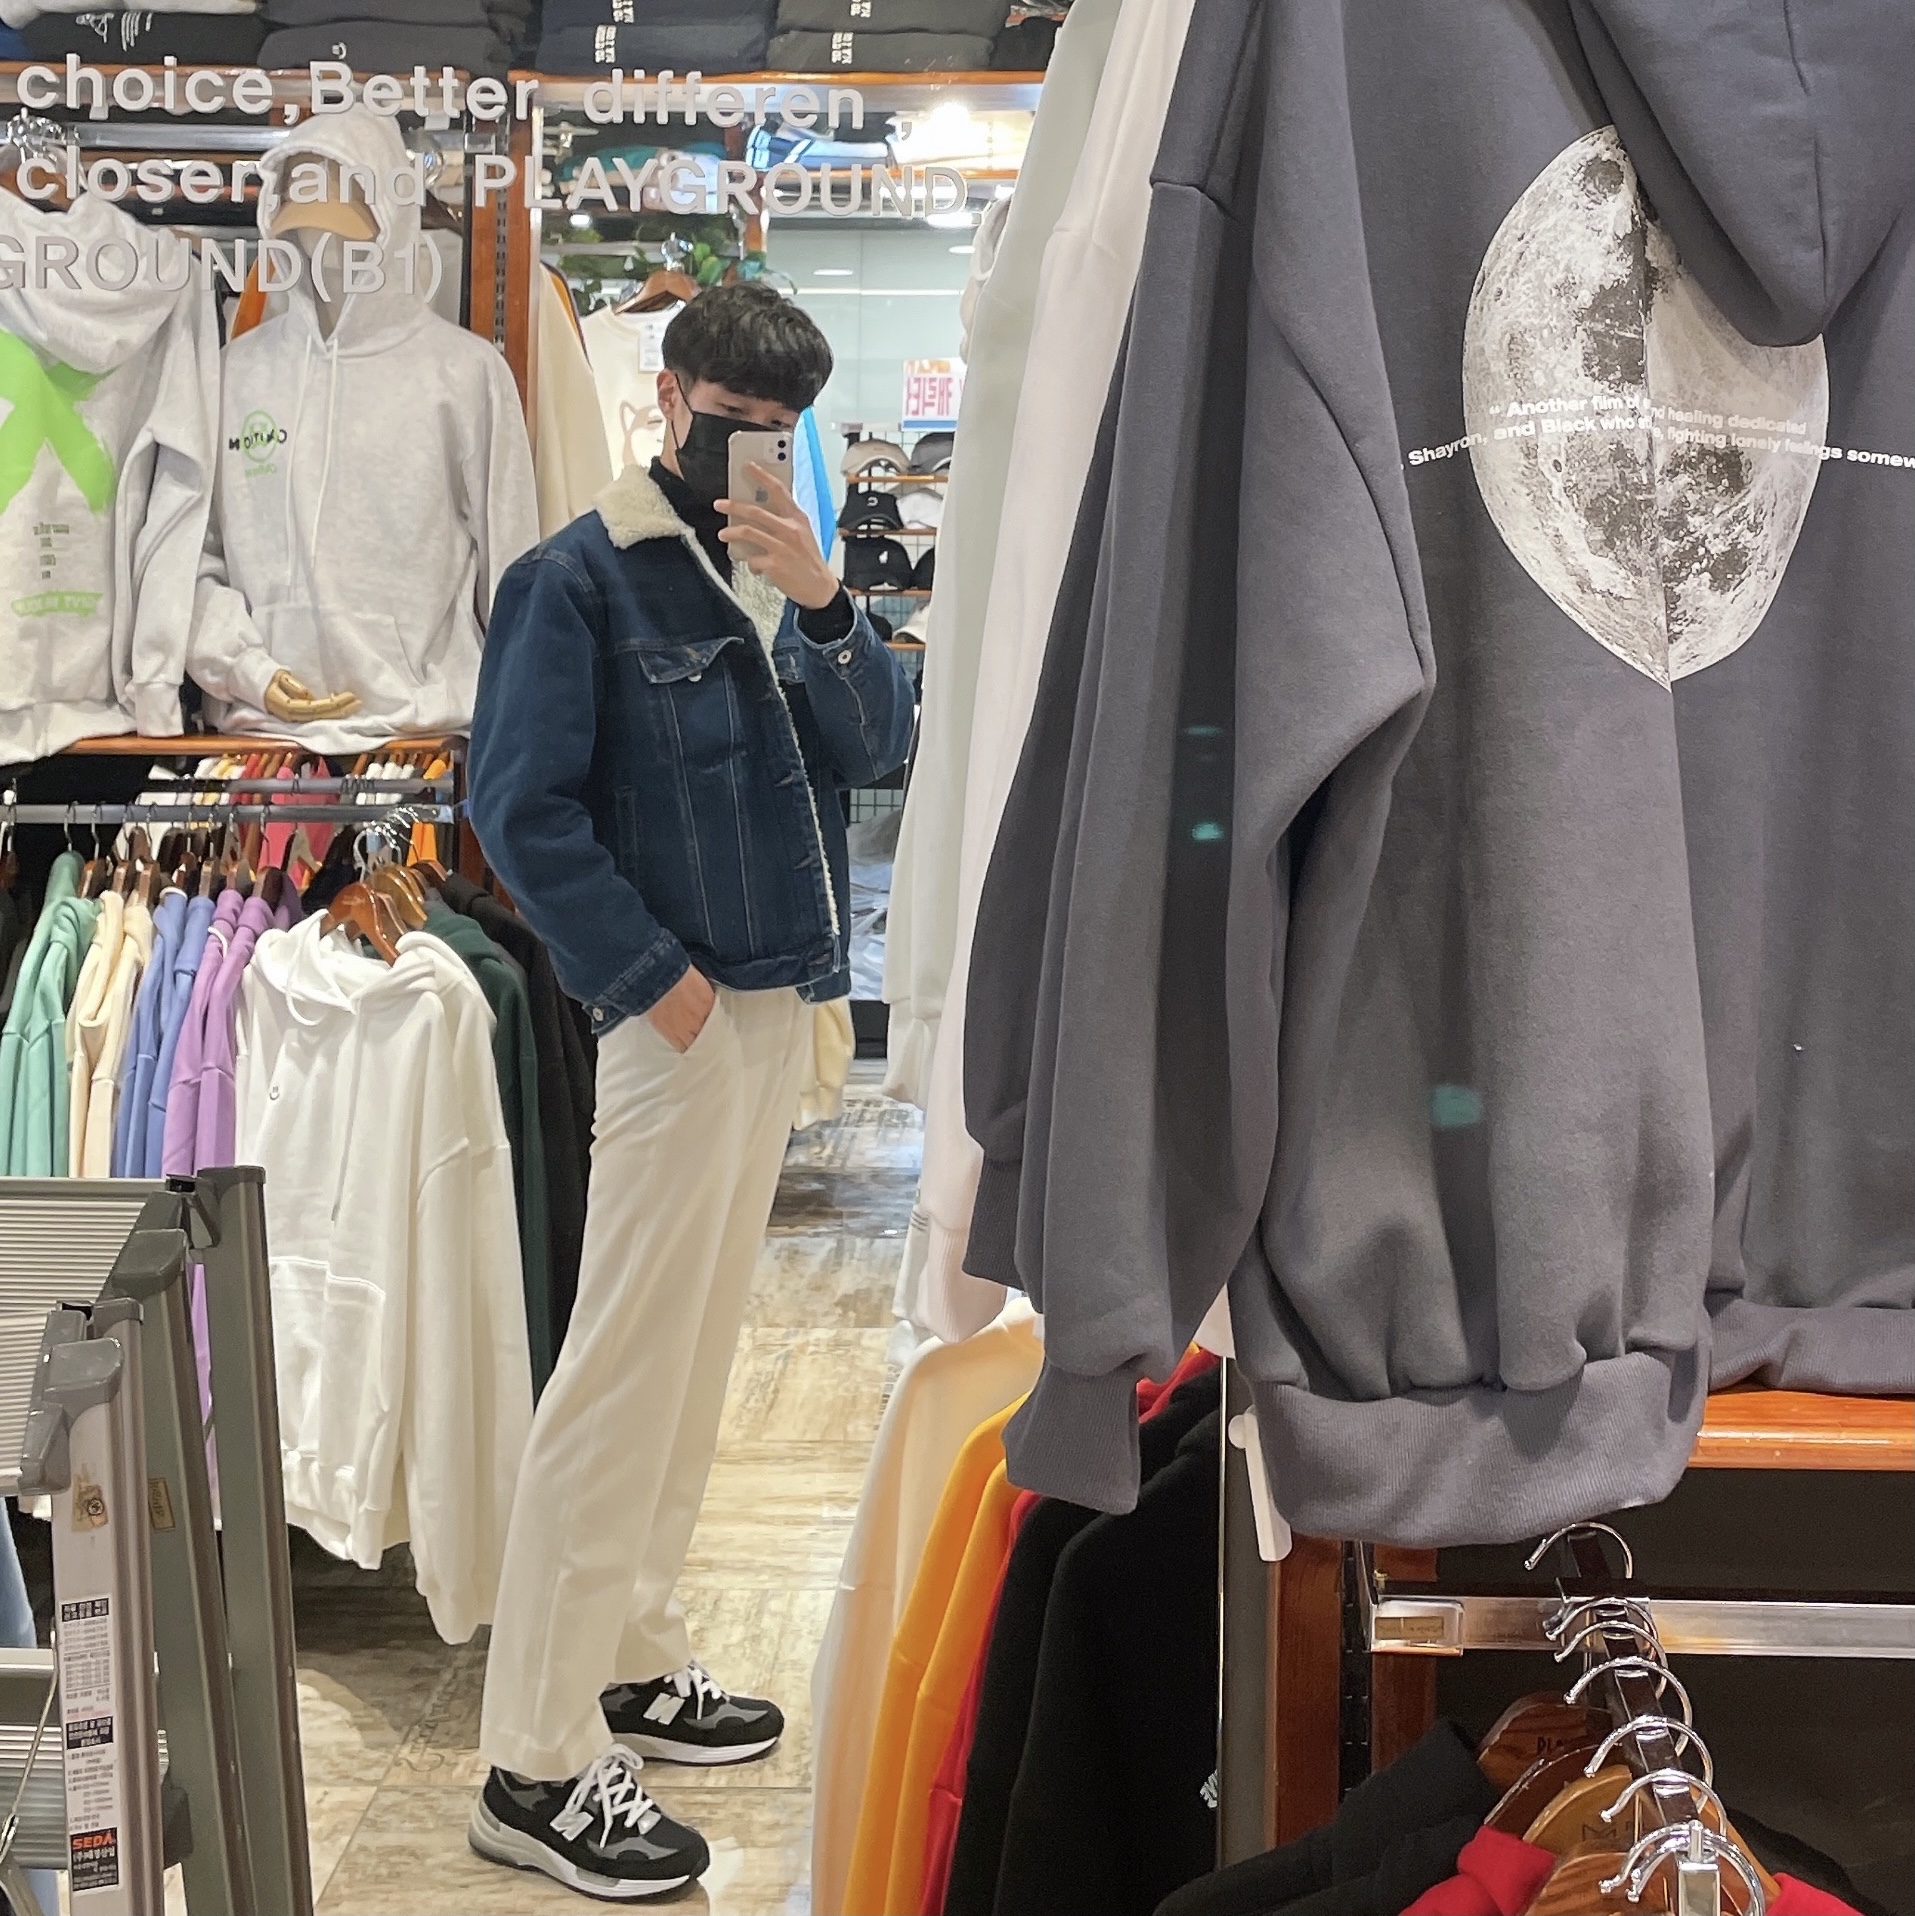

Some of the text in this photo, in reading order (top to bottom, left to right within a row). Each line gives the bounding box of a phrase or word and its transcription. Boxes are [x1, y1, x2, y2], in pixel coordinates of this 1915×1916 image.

[474, 154, 968, 219] PLAYGROUND
[1493, 420, 1535, 440] and
[1540, 416, 1597, 434] Black
[1600, 415, 1635, 431] who
[1667, 426, 1727, 449] fighting
[1730, 433, 1782, 453] lonely
[1506, 397, 1588, 418] Another
[1591, 395, 1624, 411] film
[1667, 407, 1723, 429] healing
[1728, 414, 1806, 435] dedicated
